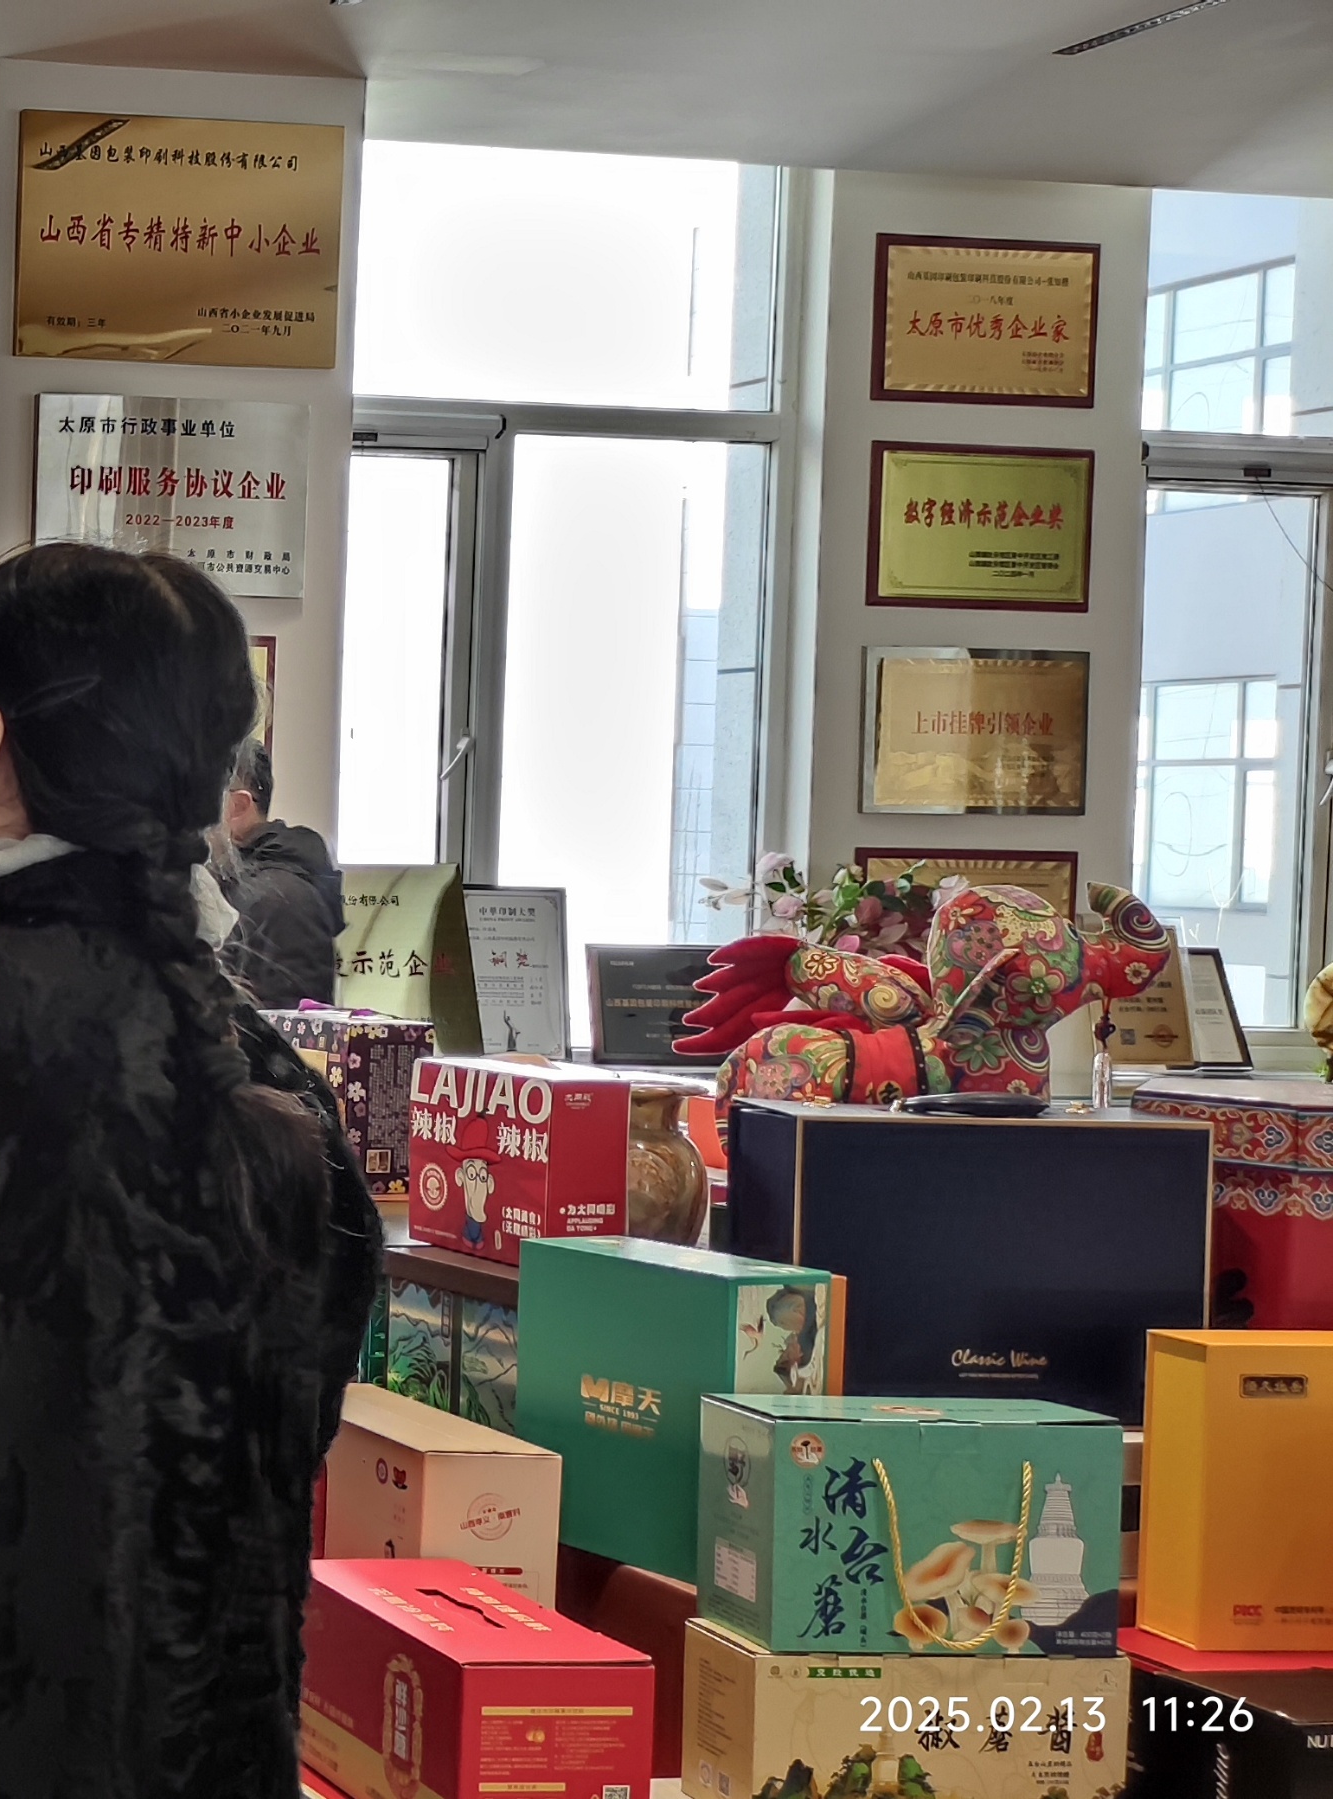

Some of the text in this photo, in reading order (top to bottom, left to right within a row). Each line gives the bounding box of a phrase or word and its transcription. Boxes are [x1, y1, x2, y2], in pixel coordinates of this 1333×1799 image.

[39, 212, 322, 258] 山西省专精特新中小企业
[197, 307, 316, 323] 山西省小企业发展促进局
[906, 309, 1070, 344] 太原市优秀企业家
[58, 416, 236, 439] 太原市行政事业单位
[69, 465, 287, 501] 印刷服务协议企业
[911, 710, 1054, 736] 上市挂牌引领企业
[343, 893, 400, 907] 份有限公司
[410, 1060, 552, 1124] LAJIAO
[410, 1106, 458, 1146] 辣椒
[496, 1122, 549, 1164] 辣椒
[951, 1347, 1049, 1369] Classic Wine
[1306, 1734, 1333, 1750] NU
